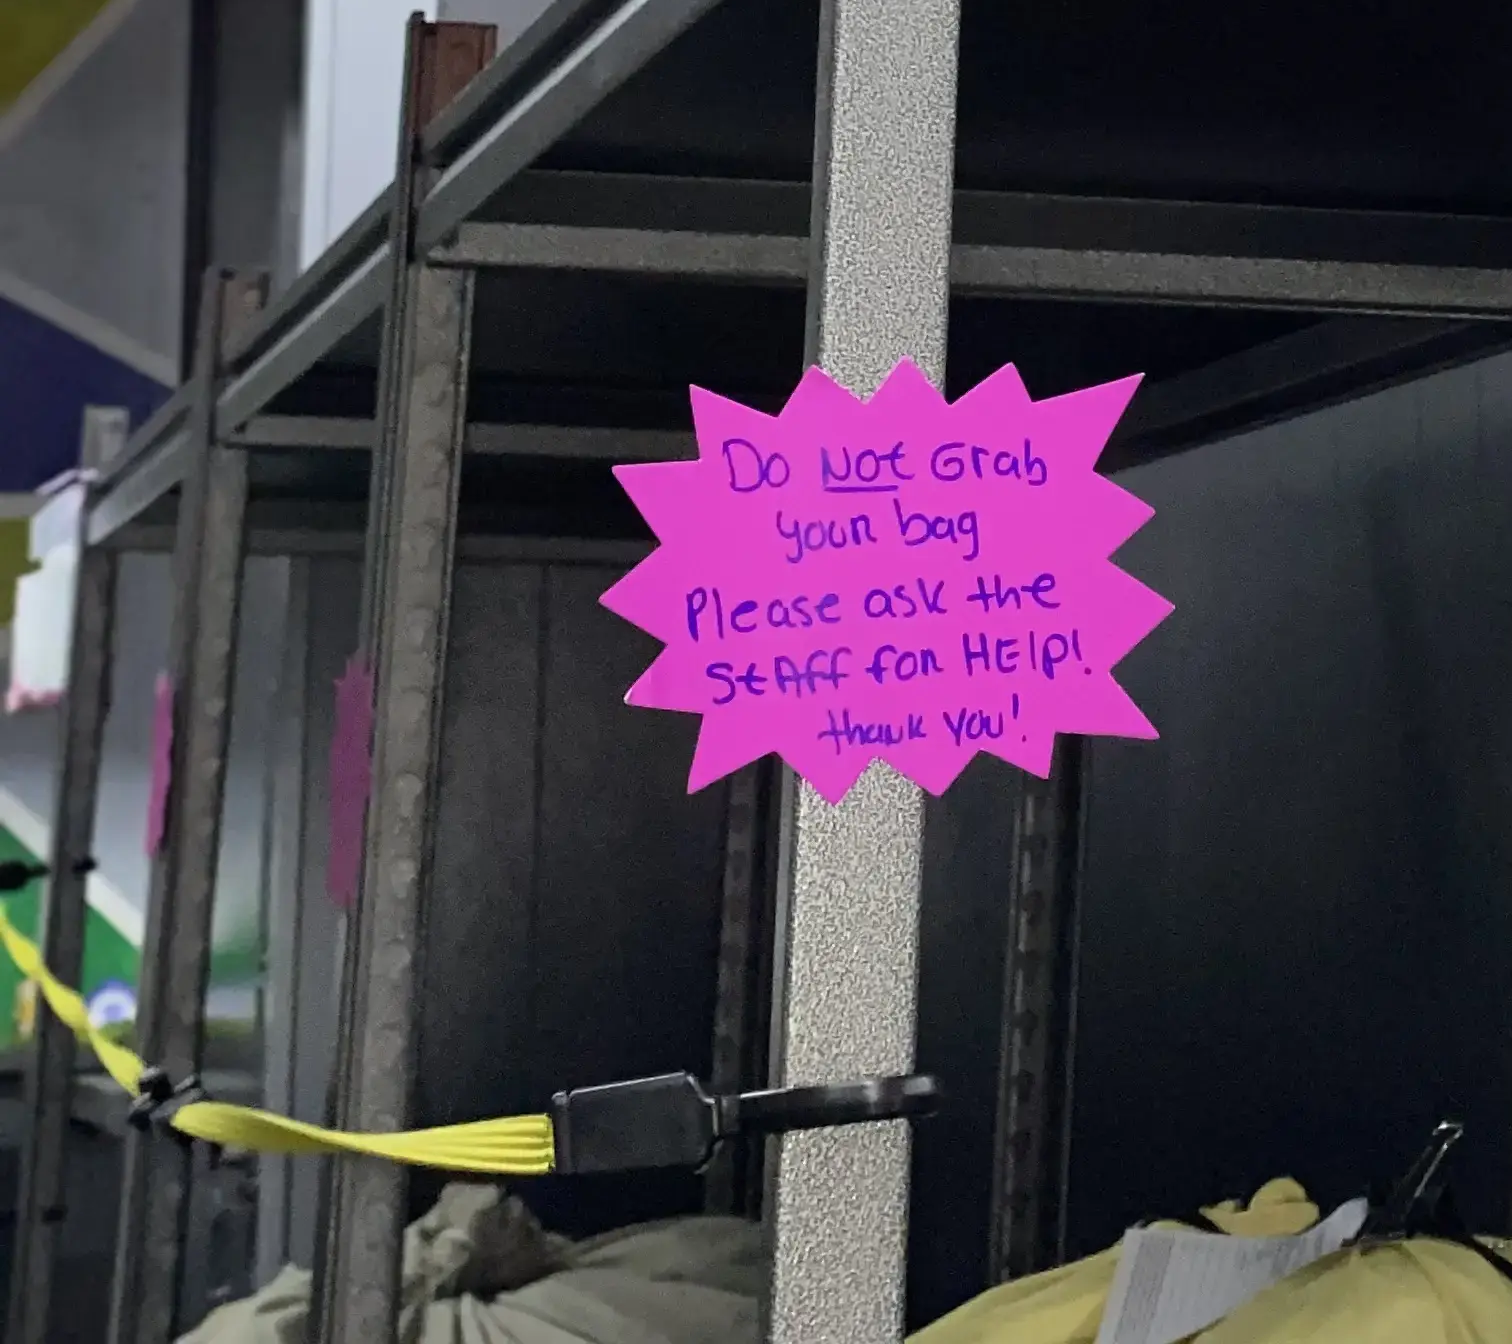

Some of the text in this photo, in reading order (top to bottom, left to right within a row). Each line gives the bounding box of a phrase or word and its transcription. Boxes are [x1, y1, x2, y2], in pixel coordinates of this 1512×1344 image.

[722, 438, 790, 493] Do
[930, 437, 1048, 487] Grab
[893, 498, 980, 562] bag
[686, 572, 1061, 642] Please ask the
